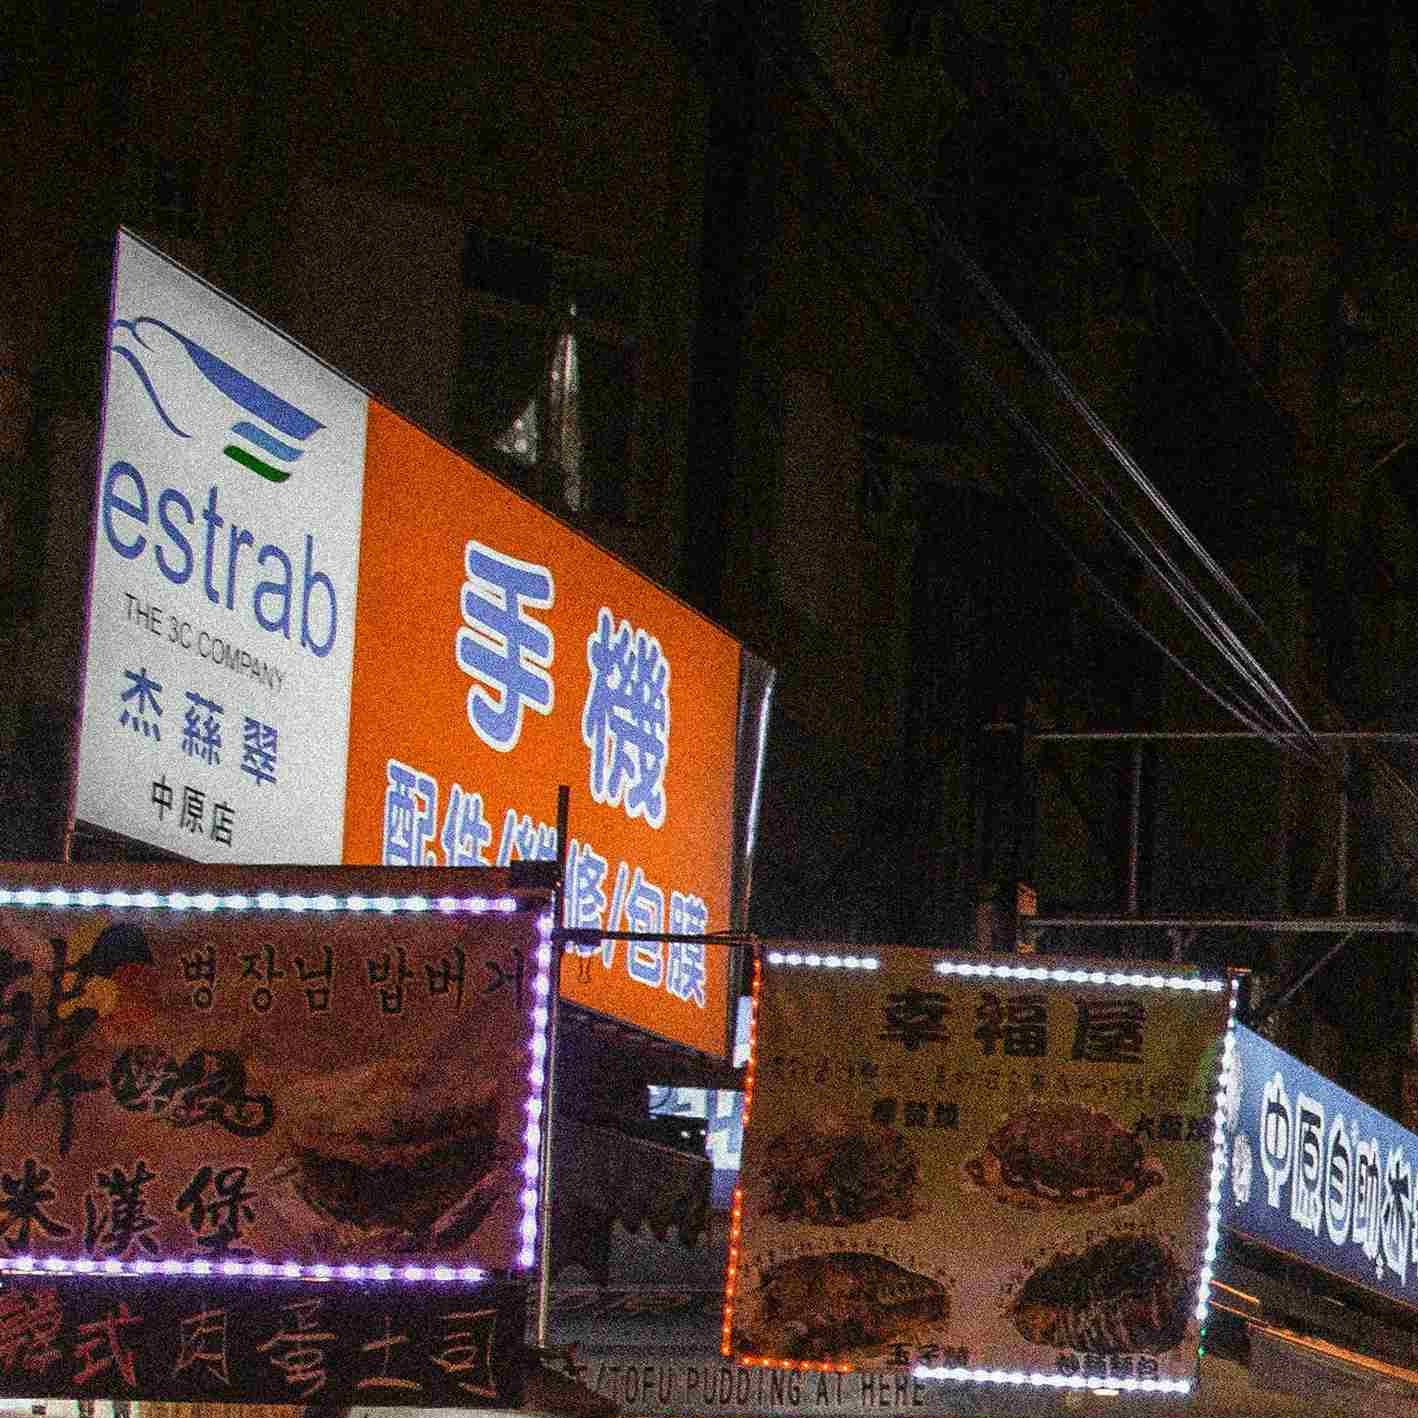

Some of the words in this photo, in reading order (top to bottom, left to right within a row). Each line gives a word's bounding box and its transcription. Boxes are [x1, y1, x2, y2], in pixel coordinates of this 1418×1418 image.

[101, 460, 338, 658] estrab
[124, 592, 162, 636] THE
[168, 616, 192, 649] 3C
[198, 631, 283, 691] COMPANY
[454, 539, 672, 829] 手機
[152, 775, 236, 848] 中原店
[183, 946, 334, 1011] 병장님
[882, 989, 1147, 1062] 幸福屋
[686, 1366, 800, 1404] PUDDING
[815, 1370, 844, 1405] AT
[861, 1370, 926, 1407] HERE
